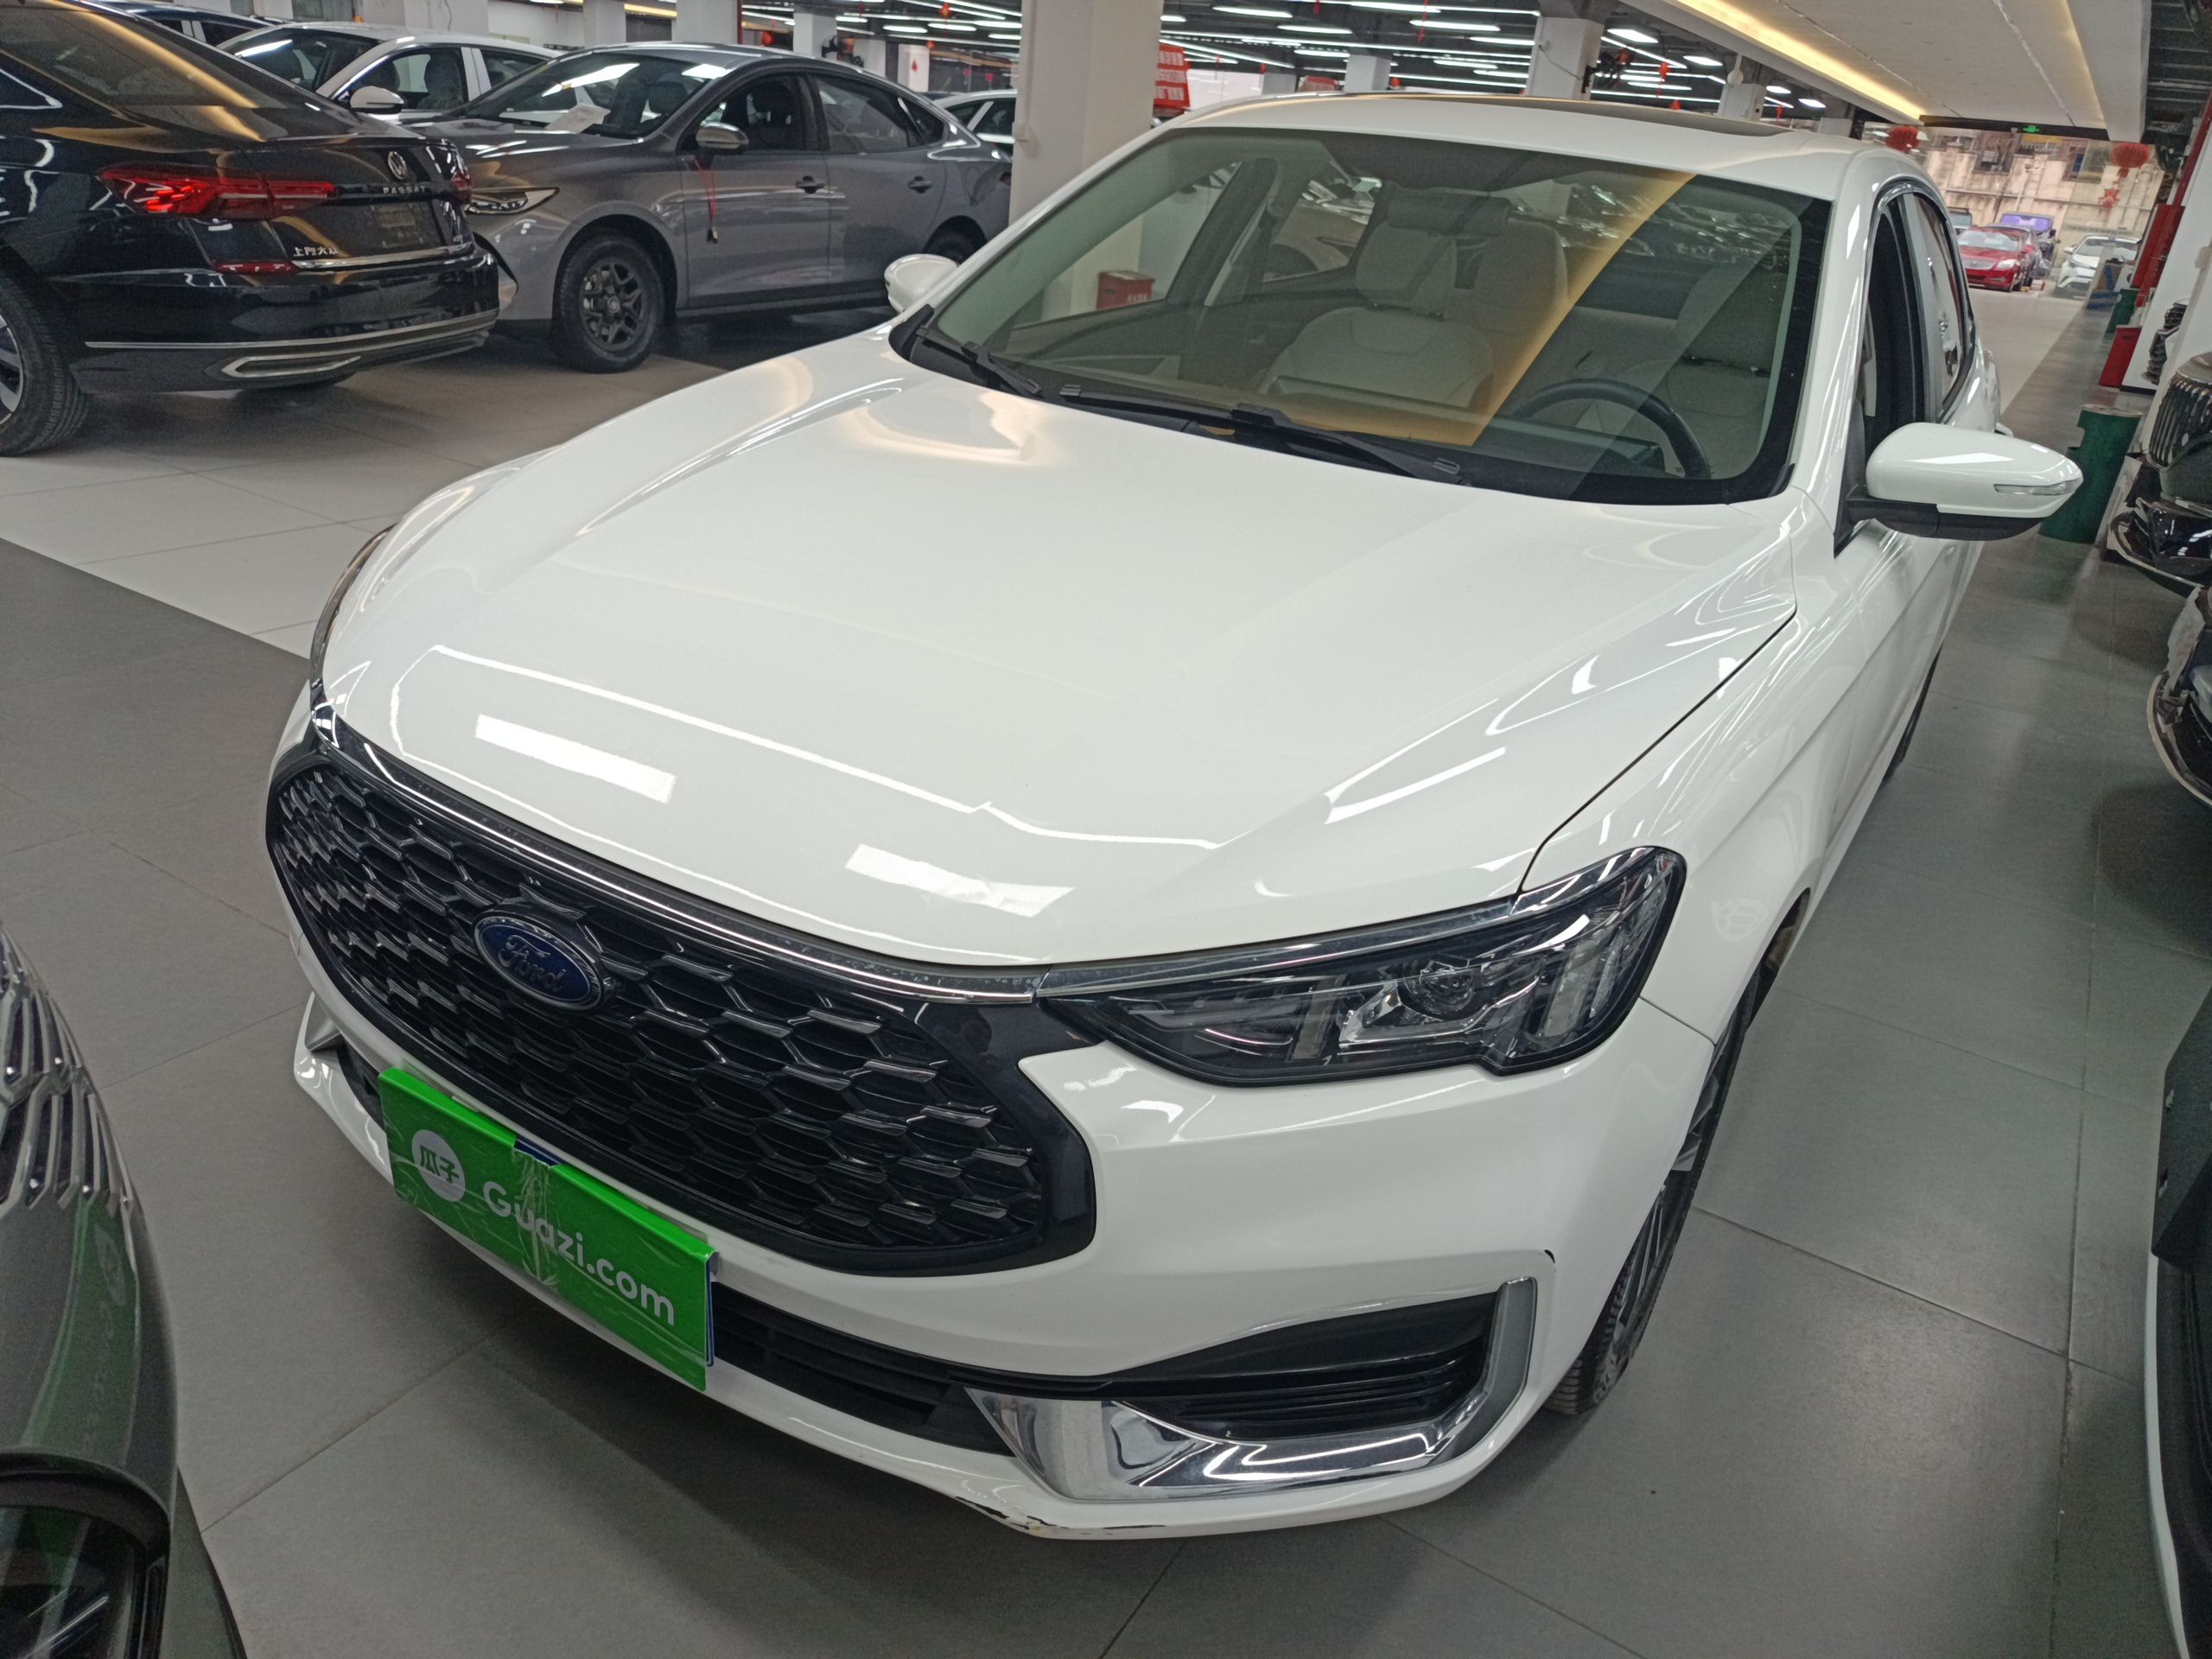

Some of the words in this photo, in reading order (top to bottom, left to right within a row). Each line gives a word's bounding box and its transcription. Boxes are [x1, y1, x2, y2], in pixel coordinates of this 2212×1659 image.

[383, 186, 426, 194] PASSAT
[498, 935, 566, 992] Ford
[419, 1144, 460, 1185] 瓜子
[482, 1180, 675, 1326] Guazi.com
